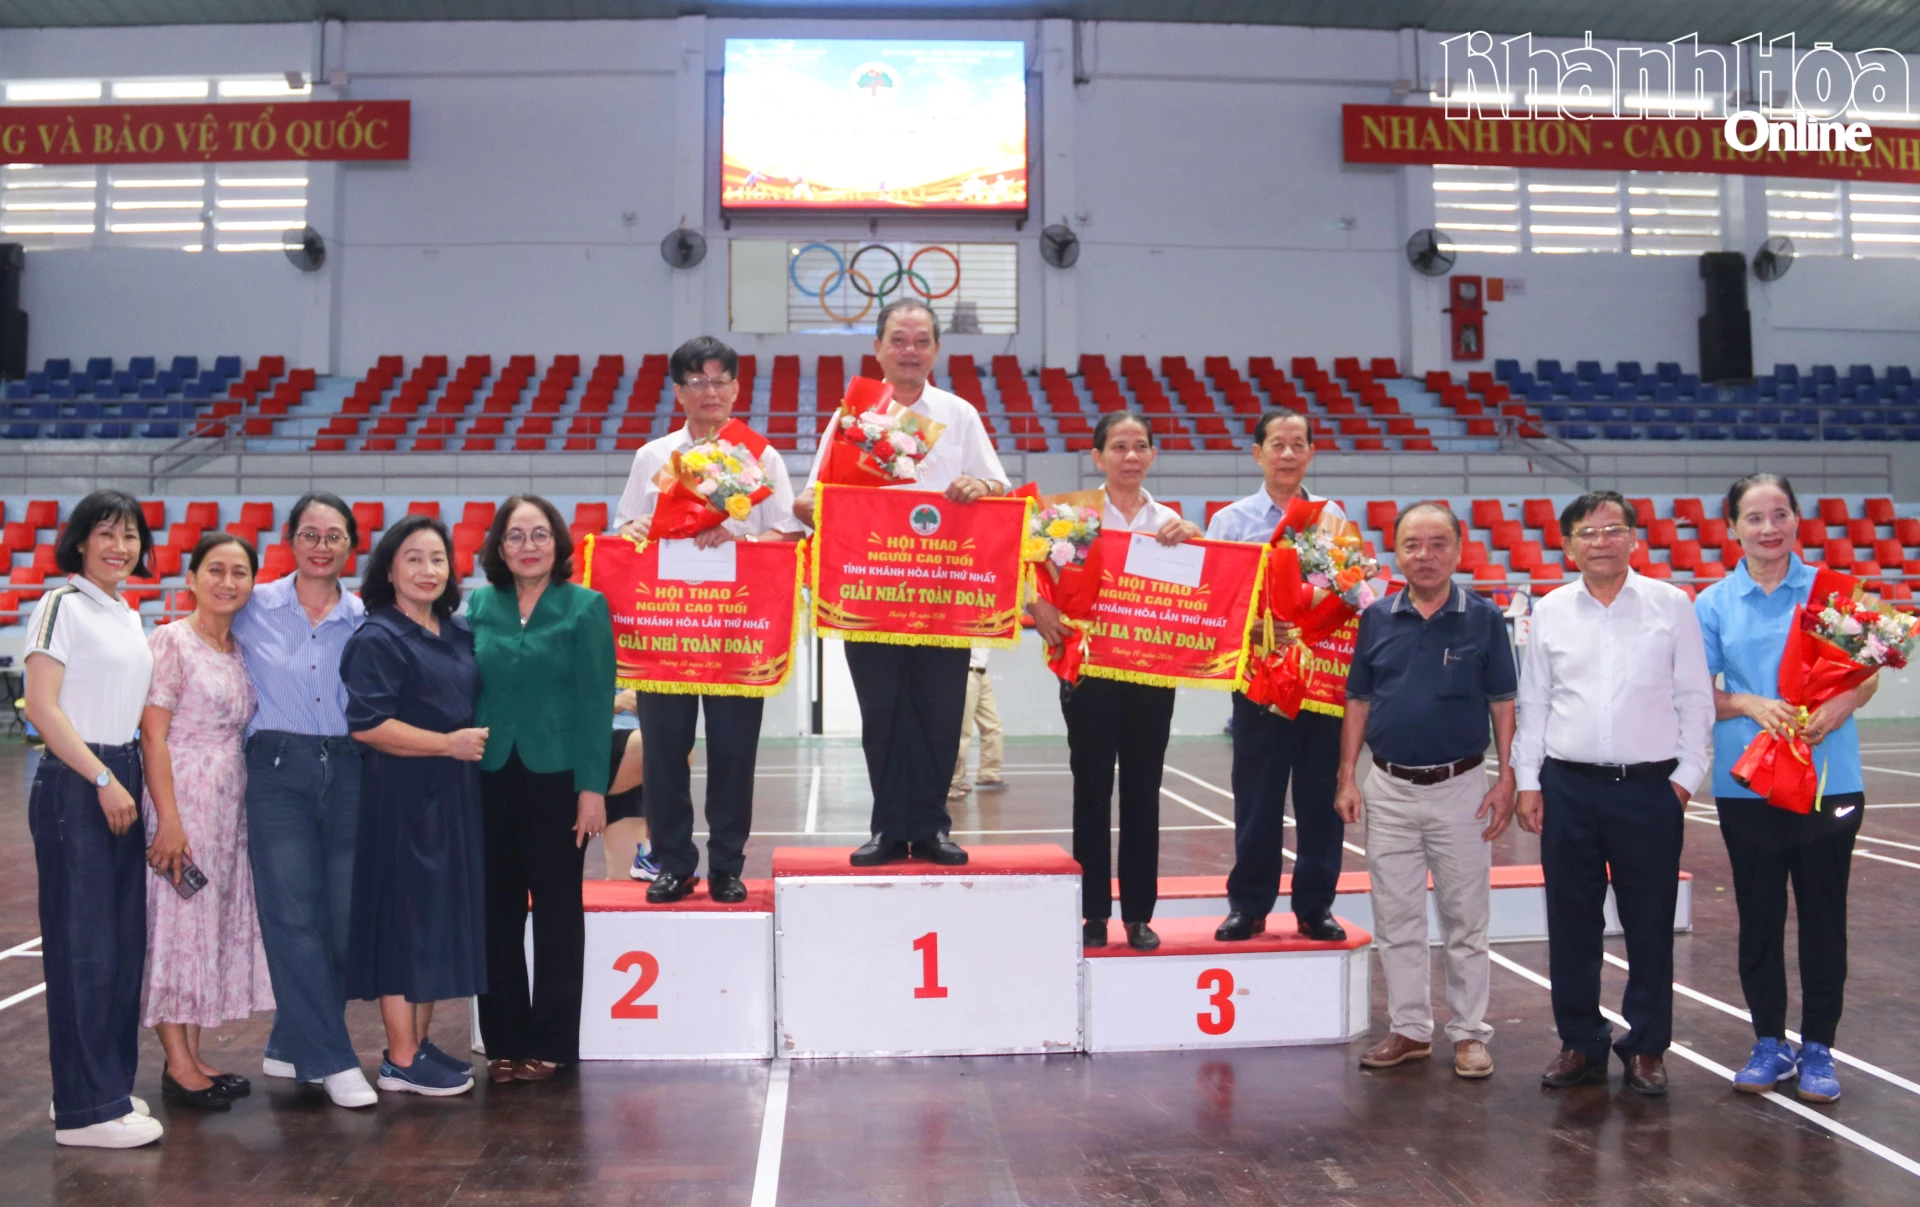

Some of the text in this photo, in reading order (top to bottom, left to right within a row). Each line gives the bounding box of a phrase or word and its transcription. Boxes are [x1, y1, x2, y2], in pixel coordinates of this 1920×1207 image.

[0, 105, 389, 160] G VÀ BẢO VỆ TỔ QUỐC
[1361, 115, 1500, 152] NHANH
[1511, 119, 1592, 156] HƠN
[1623, 124, 1702, 160] CAO
[887, 535, 957, 552] HỘI THAO
[867, 548, 912, 563] NGƯỜI
[916, 553, 942, 565] CAO
[843, 562, 866, 574] TỈNH
[869, 565, 904, 577] KHÁNH
[907, 566, 929, 578] HÒA
[949, 570, 967, 580] THỨ
[969, 571, 996, 583] NHẤT
[655, 585, 731, 600] HỘI THAO
[839, 579, 996, 608] GIẢI NHẤT TOÀN ĐOÀN
[1118, 575, 1192, 597] HỘI THAO
[636, 598, 680, 612] NGƯỜI
[684, 603, 713, 613] CAO
[1145, 594, 1172, 607] CAO
[613, 613, 634, 625] TỈNH
[637, 615, 673, 627] KHÁNH
[676, 616, 699, 628] HÒA
[724, 618, 741, 628] THỨ
[743, 618, 770, 630] NHẤT
[1098, 602, 1132, 615] KHÁNH
[1134, 606, 1157, 619] HÒA
[1181, 612, 1200, 624] THỨ
[1202, 615, 1228, 628] NHẤT
[618, 630, 648, 651] GIẢI
[651, 633, 678, 652] NHÌ
[681, 634, 721, 653] TOÀN
[1110, 622, 1129, 640] BA
[1134, 625, 1174, 645] TOÀN
[1175, 631, 1216, 651] ĐOÀN
[1331, 628, 1352, 640] AO
[1314, 657, 1351, 678] TOÀN
[912, 932, 948, 999] 1
[611, 950, 659, 1020] 2
[1196, 968, 1236, 1036] 3
